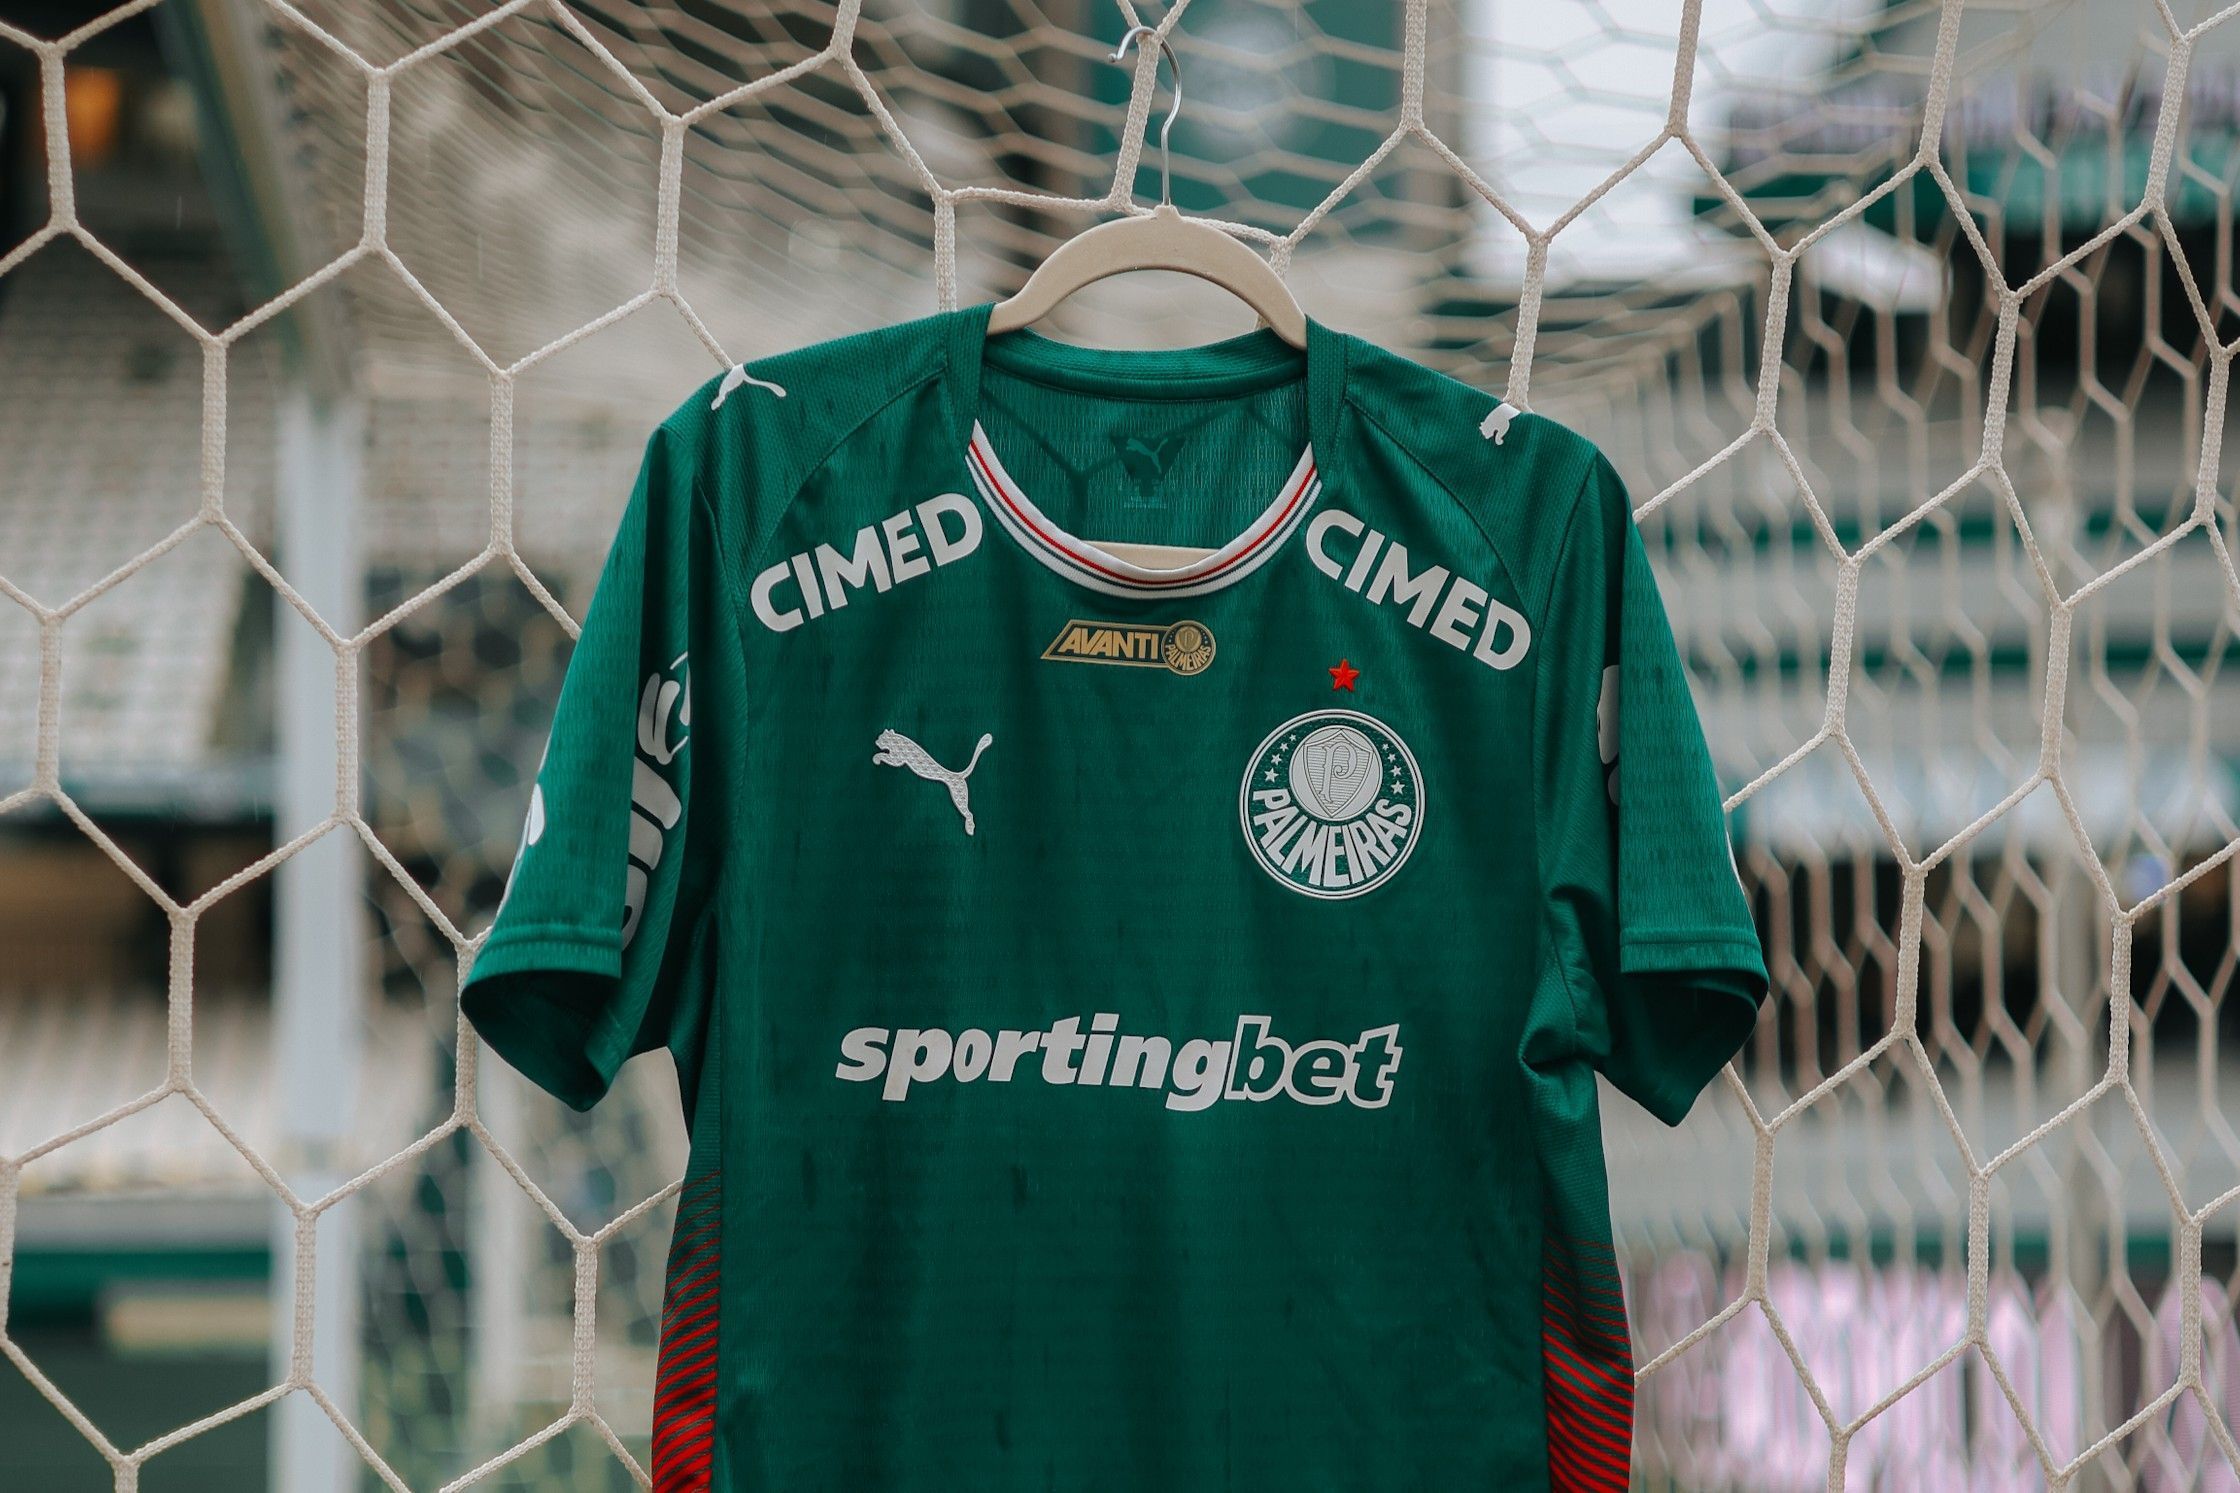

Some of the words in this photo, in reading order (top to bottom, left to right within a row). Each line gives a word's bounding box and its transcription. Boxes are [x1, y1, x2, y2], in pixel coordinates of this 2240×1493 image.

[750, 492, 984, 633] CIMED
[1305, 509, 1532, 671] CIMED
[1057, 627, 1159, 659] AVANTI
[1164, 644, 1212, 671] PALMEIRAS
[1252, 788, 1412, 888] PALMEIRAS
[835, 1012, 1404, 1112] sportingbet
